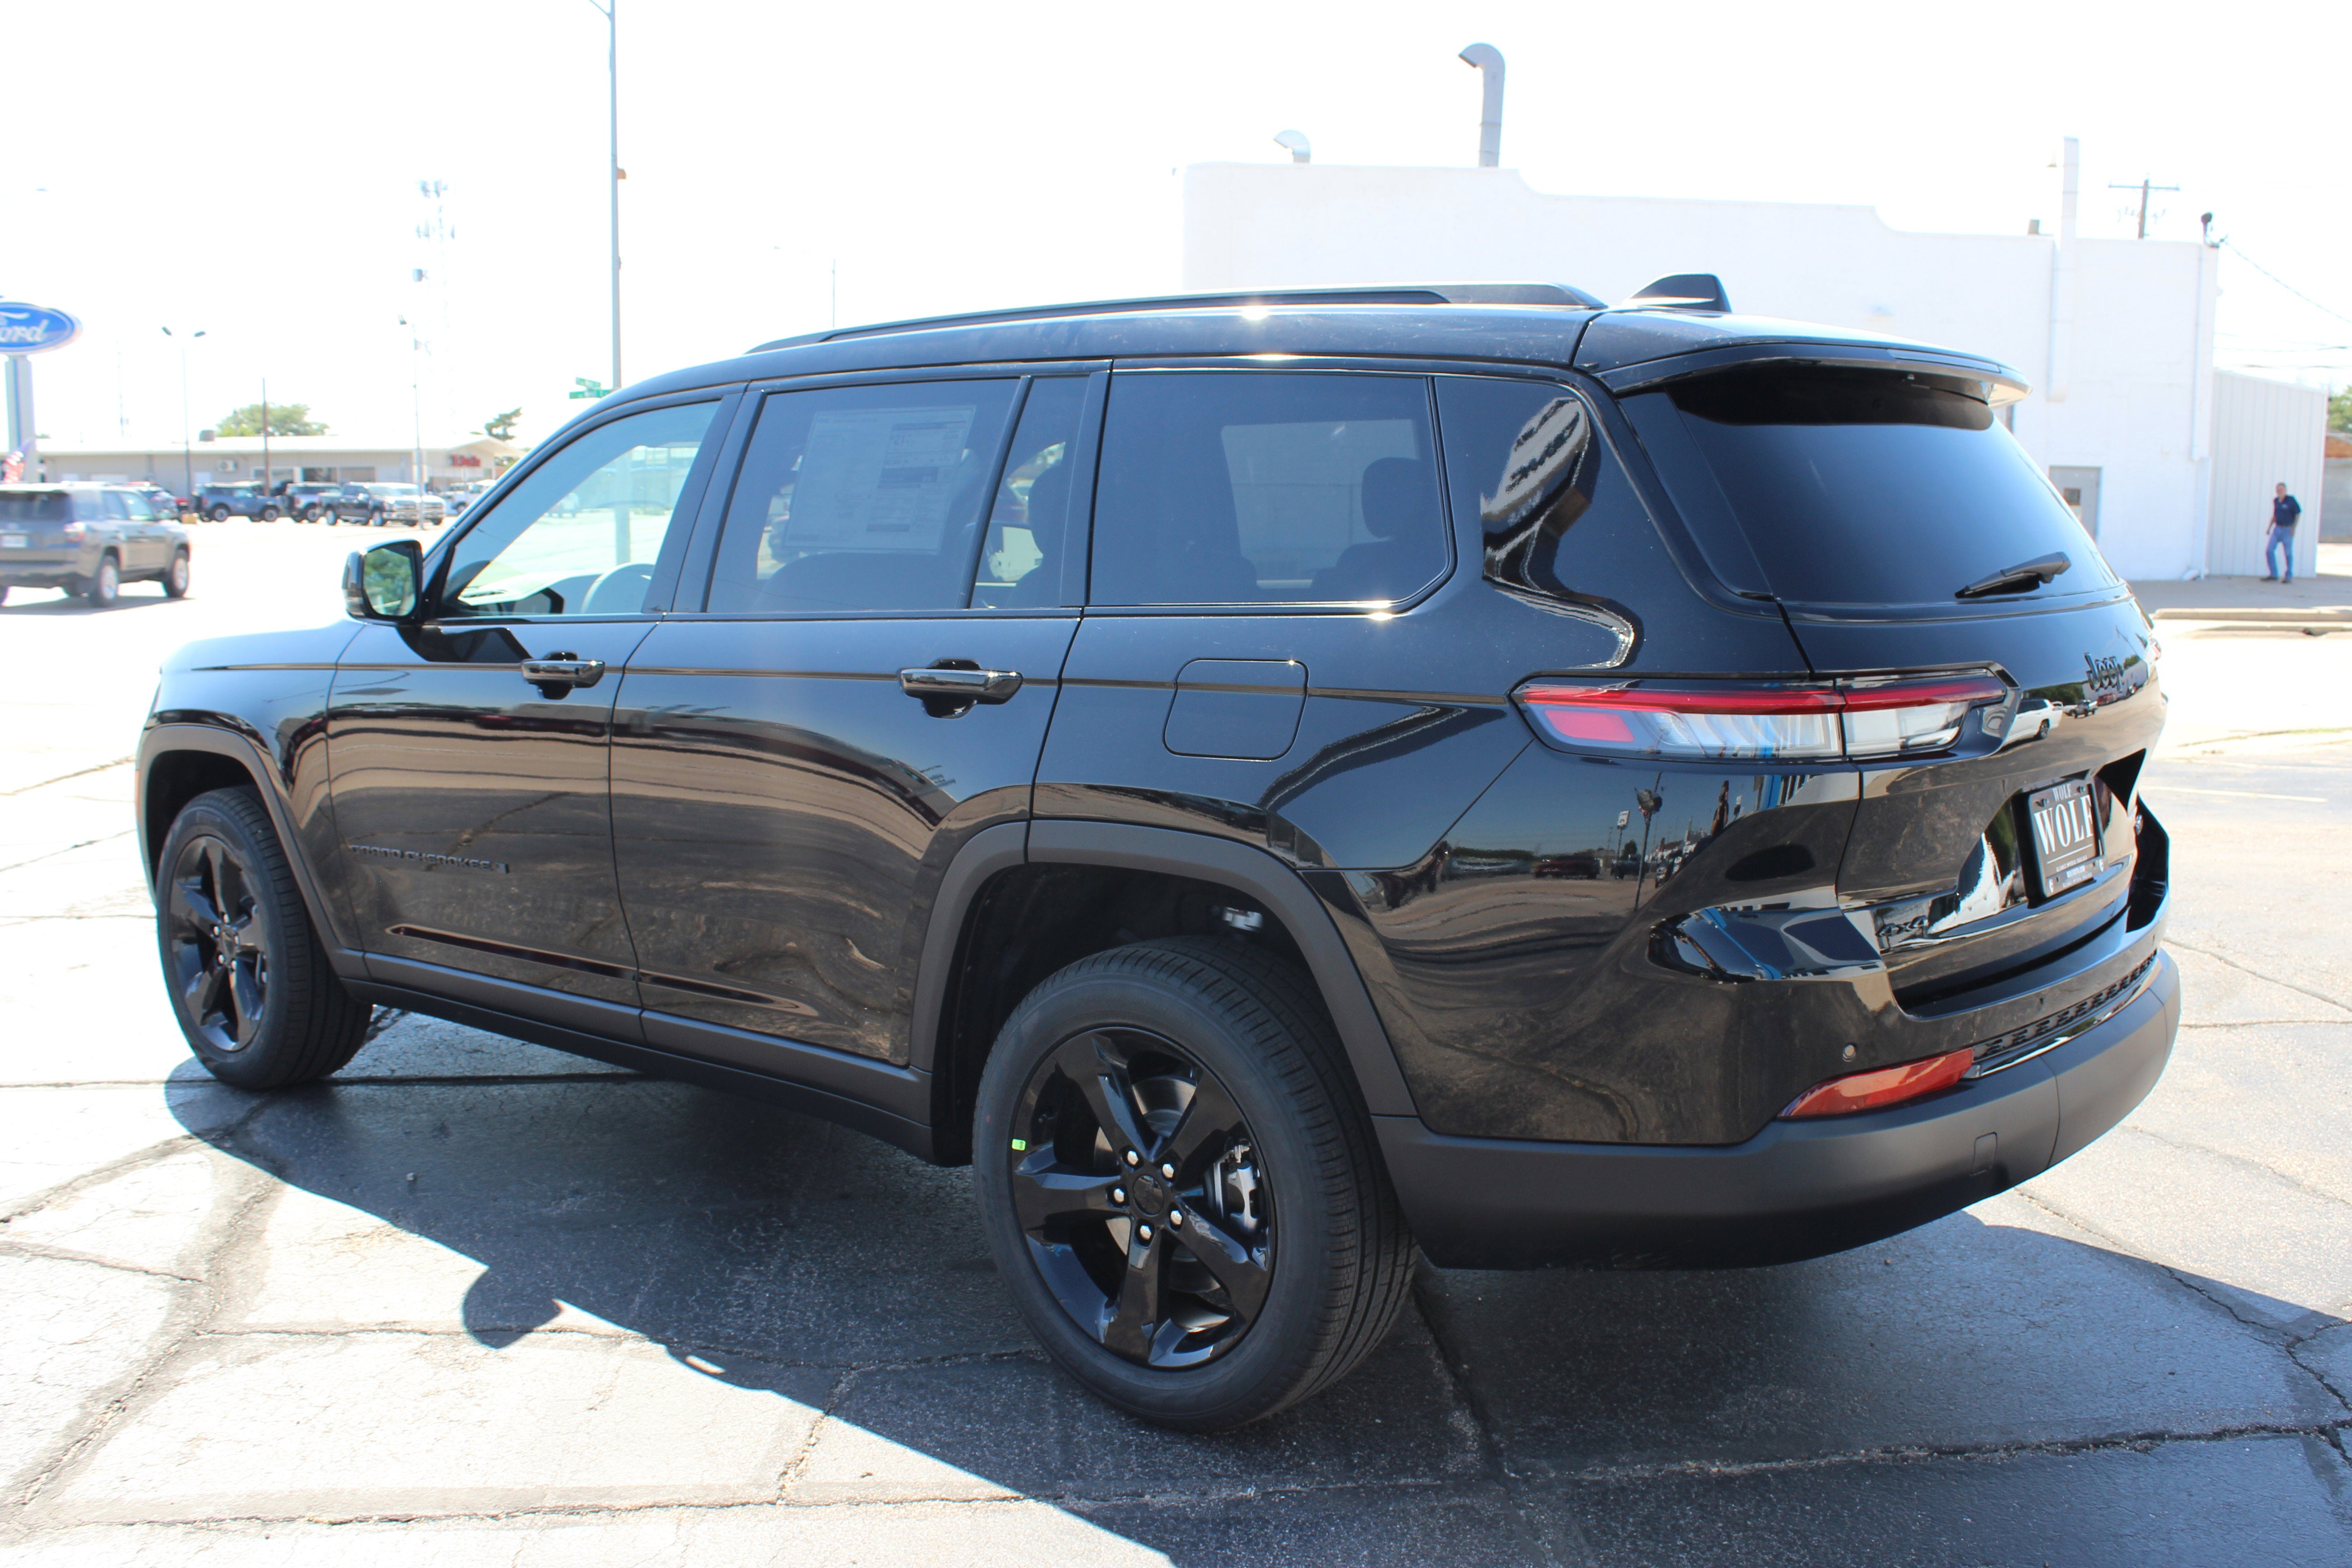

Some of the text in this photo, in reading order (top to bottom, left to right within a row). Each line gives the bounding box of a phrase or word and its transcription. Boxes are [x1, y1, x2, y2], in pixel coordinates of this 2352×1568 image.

[2084, 652, 2124, 693] Jeep
[2053, 784, 2071, 802] WOLF
[2034, 794, 2093, 855] WOLF
